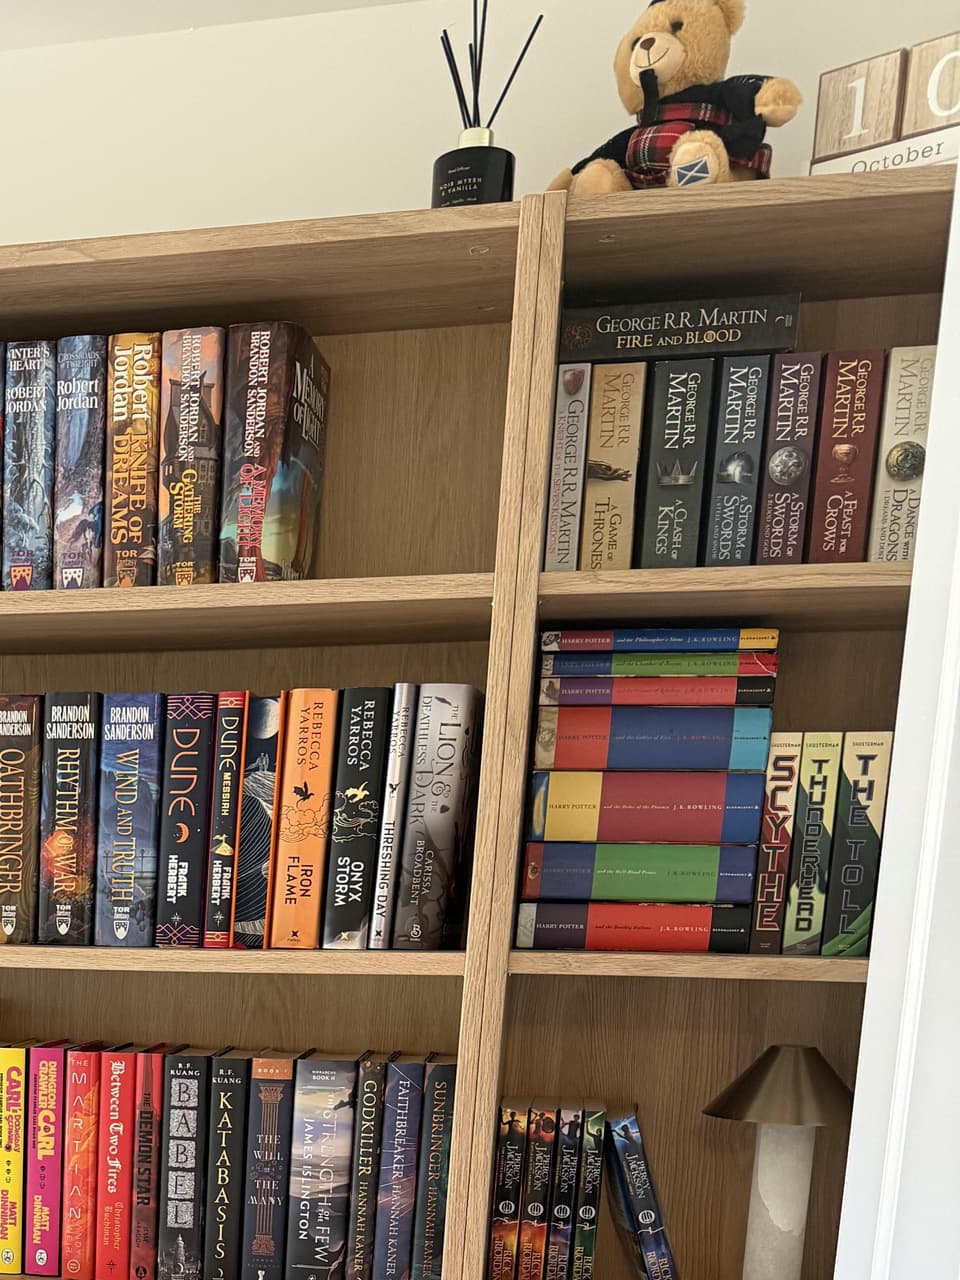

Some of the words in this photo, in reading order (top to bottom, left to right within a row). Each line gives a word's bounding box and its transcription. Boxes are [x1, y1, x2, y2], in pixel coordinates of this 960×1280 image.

[852, 141, 945, 174] October
[248, 331, 260, 387] BRANDON
[616, 335, 653, 348] FIRE
[657, 336, 682, 346] AND
[685, 329, 741, 344] BLOOD
[6, 387, 47, 400] ROBERT
[6, 401, 47, 414] JORDAN
[57, 379, 99, 395] Robert
[57, 395, 98, 411] Jordan
[113, 346, 132, 422] Jordan
[132, 343, 153, 421] Robert
[665, 373, 687, 449] MARTIN
[724, 367, 748, 444] MARTIN
[776, 364, 800, 440] MARTIN
[832, 360, 857, 438] MARTIN
[894, 358, 920, 436] MARTIN
[244, 389, 257, 457] SANDERSON
[111, 435, 130, 545] DREAMS
[591, 497, 610, 569] THRONES
[656, 506, 674, 554] KINGS
[719, 496, 739, 560] SWORDS
[770, 493, 790, 557] SWORDS
[823, 495, 843, 551] CROWS
[887, 489, 909, 561] DRAGONS
[562, 636, 583, 644] HARRY
[585, 636, 611, 644] POTTER
[46, 723, 95, 739] SANDERSON
[104, 723, 154, 740] SANDERSON
[111, 707, 149, 723] BRANDON
[308, 702, 324, 771] REBECCA
[347, 706, 362, 765] YARROS
[359, 700, 375, 771] REBECCA
[114, 749, 140, 805] WIND
[168, 728, 200, 816] DUNE
[848, 754, 878, 827] THE
[116, 808, 133, 836] AND
[755, 755, 798, 931] SCYTHE
[795, 759, 831, 932] THUNDERHEAD
[111, 838, 136, 901] TRUTH
[166, 855, 178, 904] HERBERT
[284, 856, 300, 905] FLAME
[299, 864, 313, 898] IRON
[334, 856, 350, 906] STORM
[350, 861, 364, 902] ONYX
[409, 840, 425, 905] BROADBENT
[839, 840, 866, 935] TOLL
[68, 1072, 87, 1219] MARTIAN
[166, 1078, 199, 1229] BABEL
[303, 1118, 314, 1160] JAMES
[427, 1081, 447, 1182] SUNBRINGER
[214, 1091, 232, 1259] KATABASIS
[298, 1164, 311, 1240] ISLINGTON
[625, 1153, 645, 1199] JACKSON
[638, 1160, 650, 1190] PERCY
[426, 1186, 439, 1233] HANNAH
[314, 1225, 330, 1263] FEW
[423, 1237, 436, 1278] KANER
